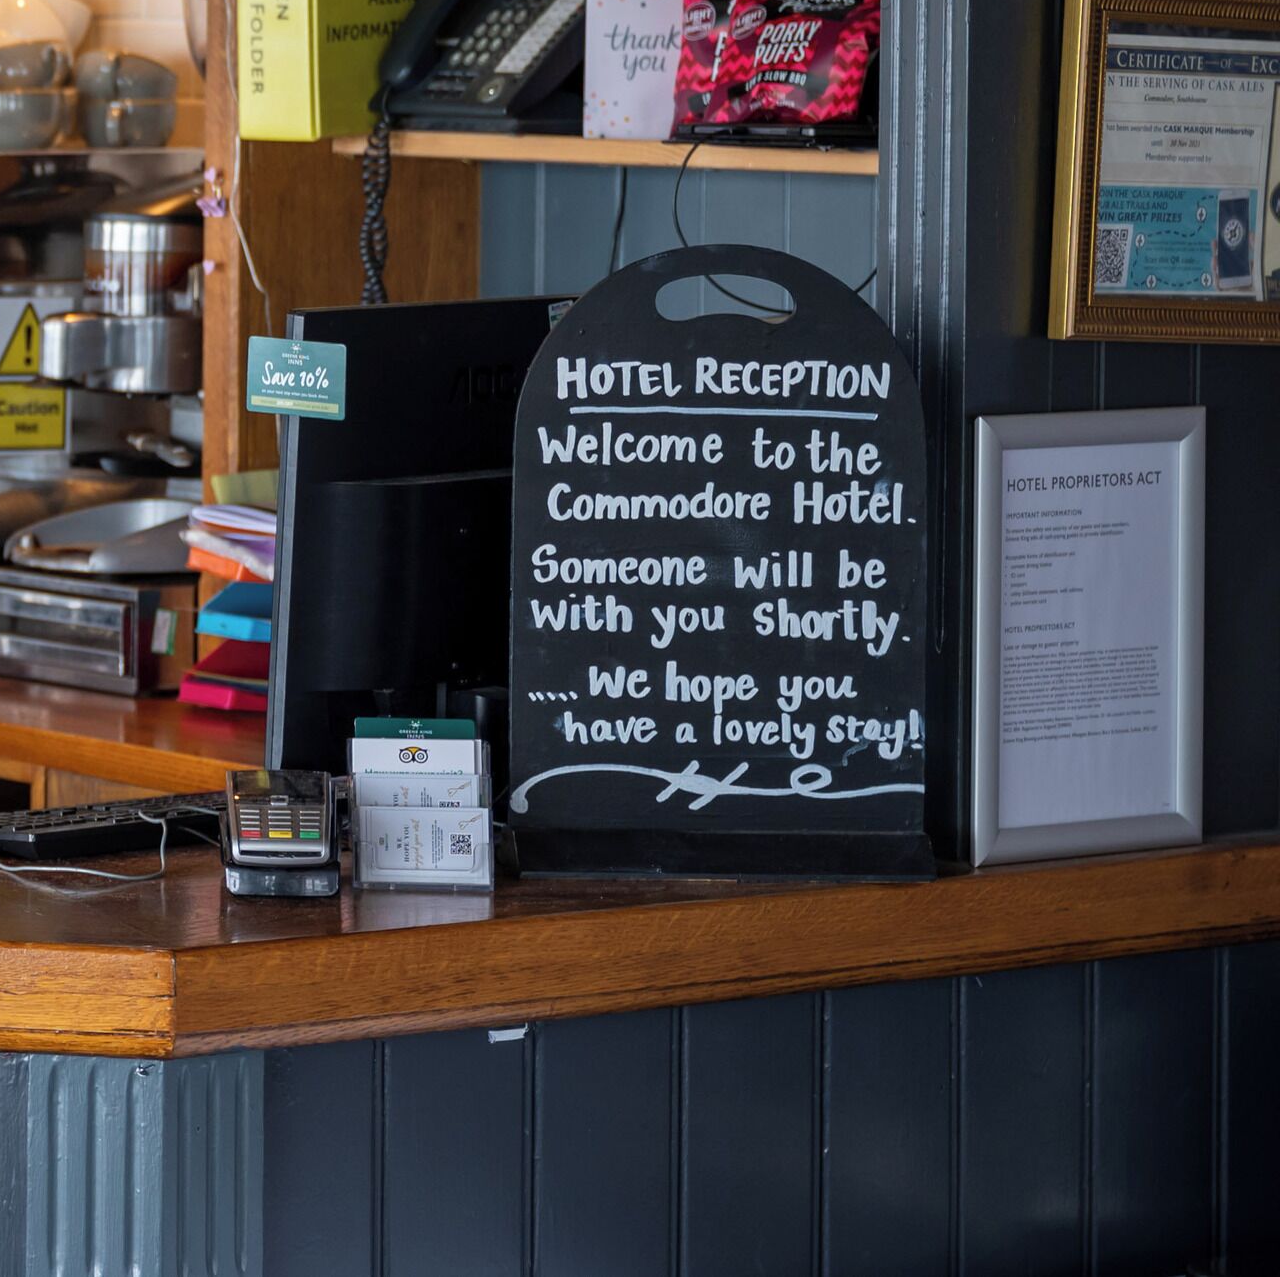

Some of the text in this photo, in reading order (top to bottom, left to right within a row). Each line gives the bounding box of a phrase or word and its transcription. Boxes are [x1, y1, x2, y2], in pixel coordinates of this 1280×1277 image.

[327, 23, 398, 43] INFORMAT
[604, 23, 682, 51] thank
[758, 20, 821, 44] PORKY
[250, 3, 264, 94] FOLDER
[753, 41, 808, 67] PUFFS
[1116, 50, 1204, 71] CERTIFICATE
[623, 54, 665, 81] you
[1120, 75, 1139, 88] THE
[1143, 76, 1188, 90] SERVING
[1191, 78, 1205, 91] OF
[1208, 80, 1236, 92] CASK
[1239, 81, 1264, 93] ALES
[1163, 125, 1182, 133] CASK
[1183, 126, 1213, 135] MARQUE
[1215, 128, 1255, 137] Membership
[1116, 190, 1129, 199] THE
[1117, 211, 1148, 222] GREAT
[1151, 212, 1183, 223] PRIZES
[262, 361, 329, 390] Save 10%
[557, 357, 890, 399] HOTEL RECEPTION
[538, 422, 882, 475] Welcome to the
[1007, 470, 1163, 493] HOTEL PROPRIETORS ACT
[547, 480, 916, 525] Commodore Hotel.
[1006, 509, 1083, 520] IMPORTANT INFORMATION
[531, 543, 708, 586] Someone
[838, 549, 887, 588] be
[651, 605, 725, 649] you
[665, 660, 759, 715] hope
[777, 675, 858, 712] you
[563, 709, 924, 759] have a lovely stay!
